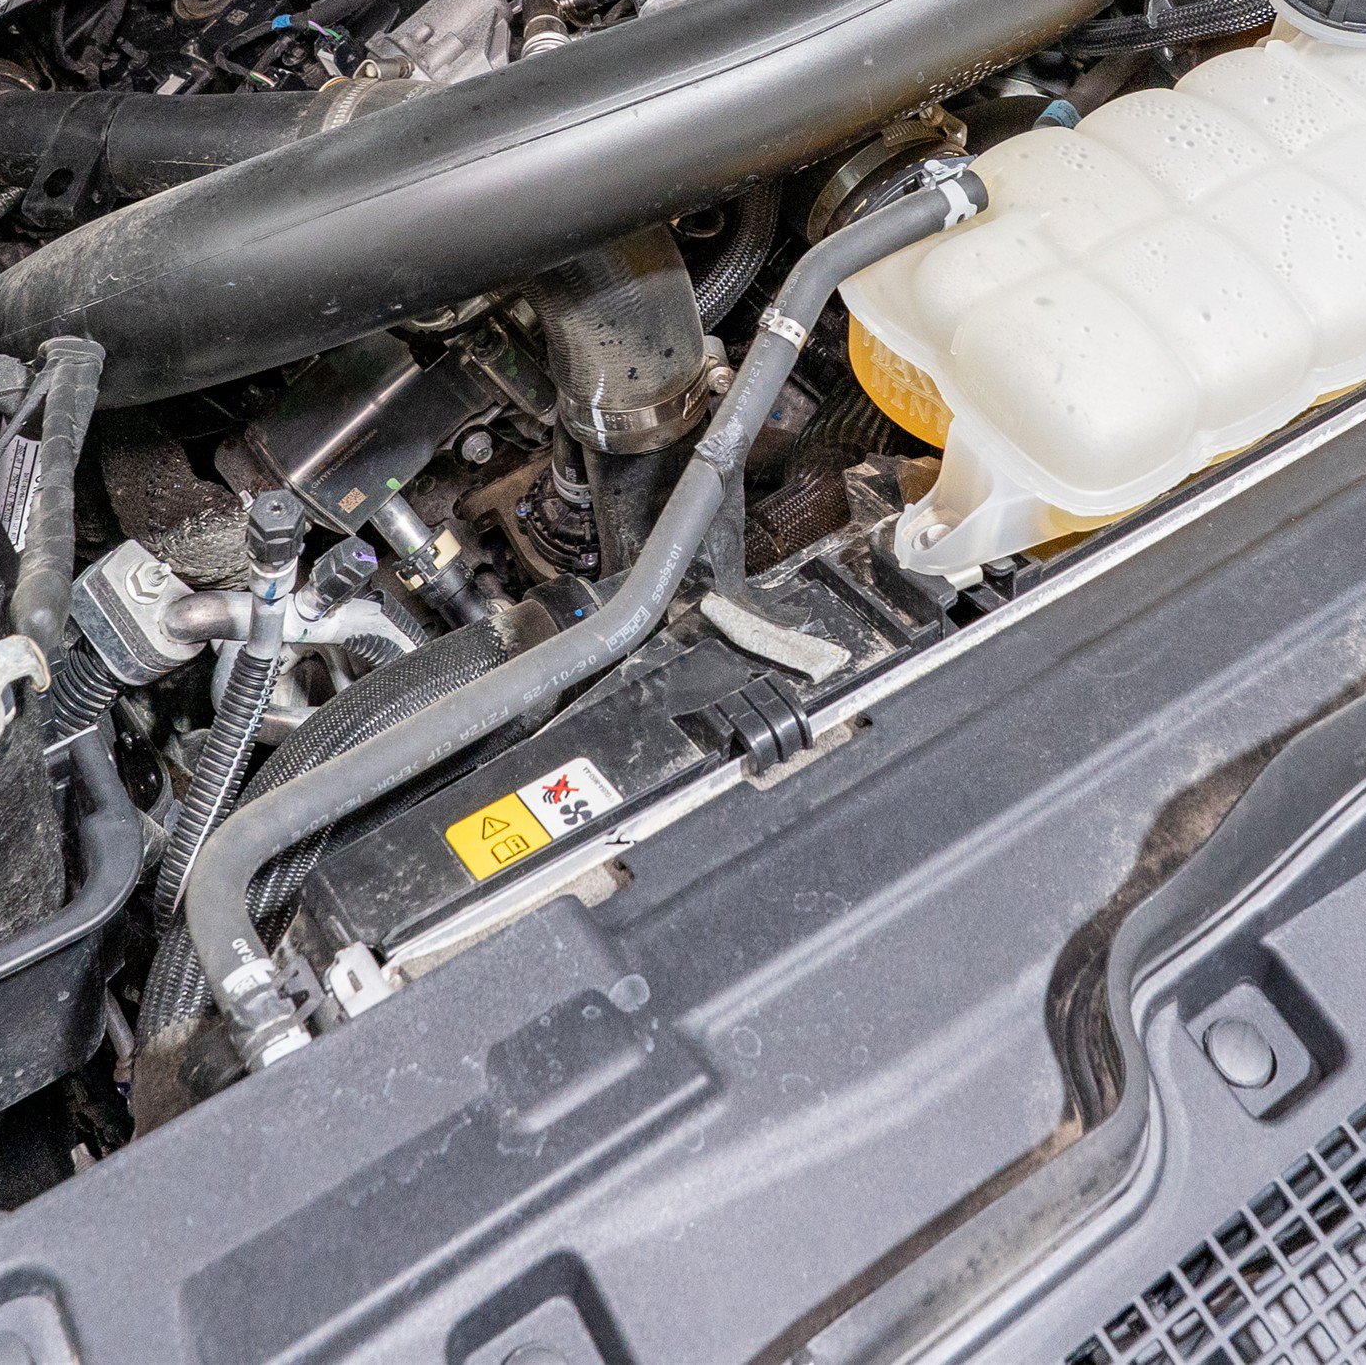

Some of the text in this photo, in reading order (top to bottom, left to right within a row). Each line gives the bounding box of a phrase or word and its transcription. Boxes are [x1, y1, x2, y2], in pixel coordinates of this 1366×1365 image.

[649, 540, 683, 606] 1036865
[520, 652, 598, 704] 06/01/25
[423, 739, 453, 762] CIP
[233, 938, 256, 961] RAD
